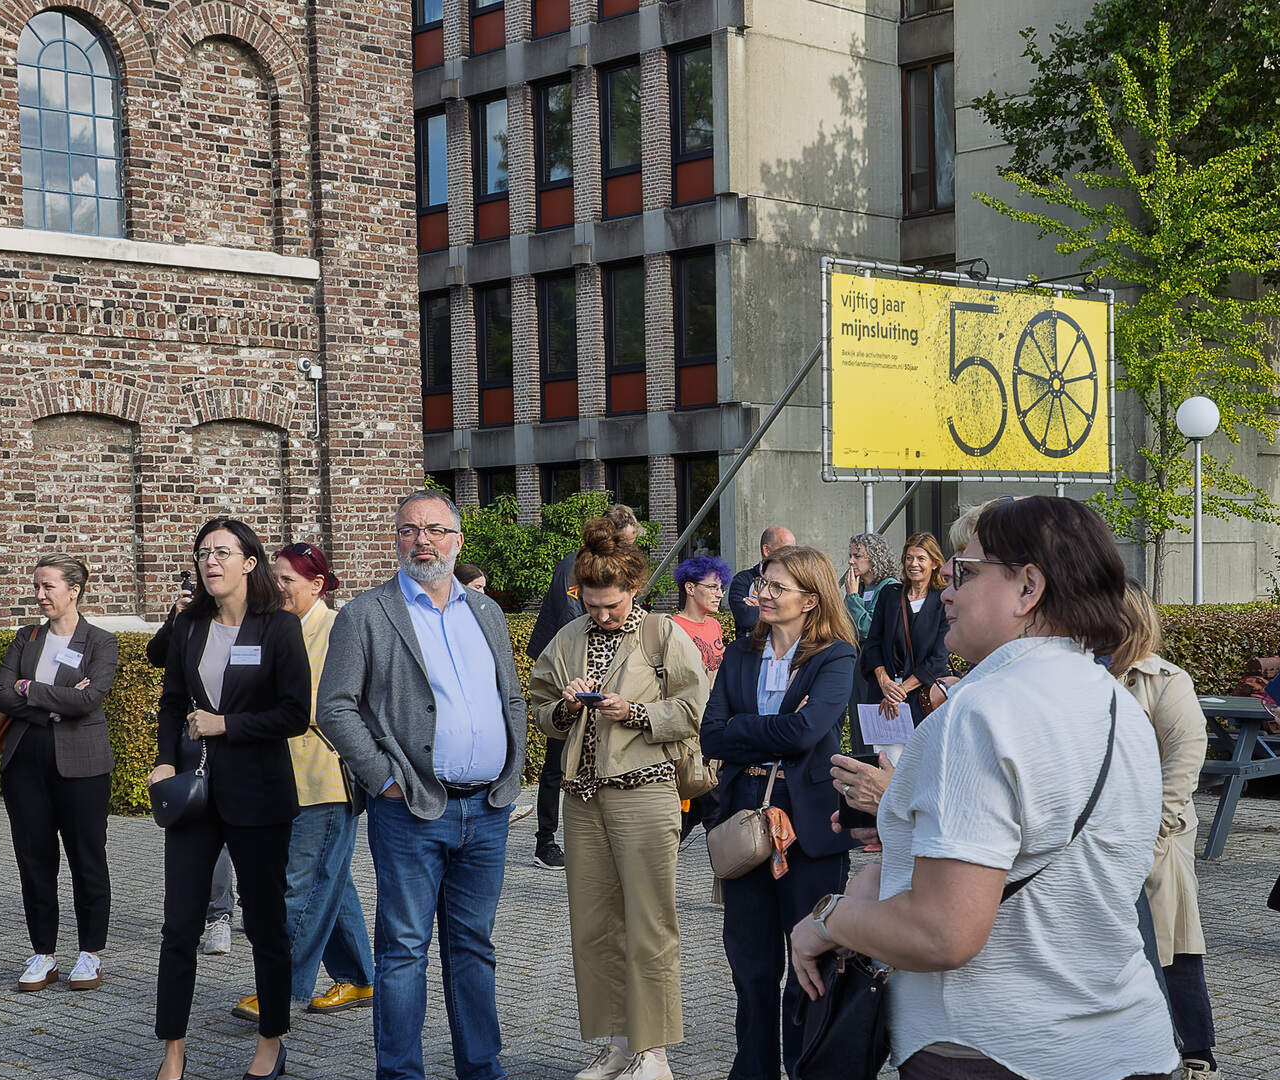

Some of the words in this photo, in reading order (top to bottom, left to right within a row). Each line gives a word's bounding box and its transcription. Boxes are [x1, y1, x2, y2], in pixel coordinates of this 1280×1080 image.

[841, 290, 878, 315] vijftig
[882, 293, 906, 316] jaar
[841, 318, 919, 346] mijnsluiting
